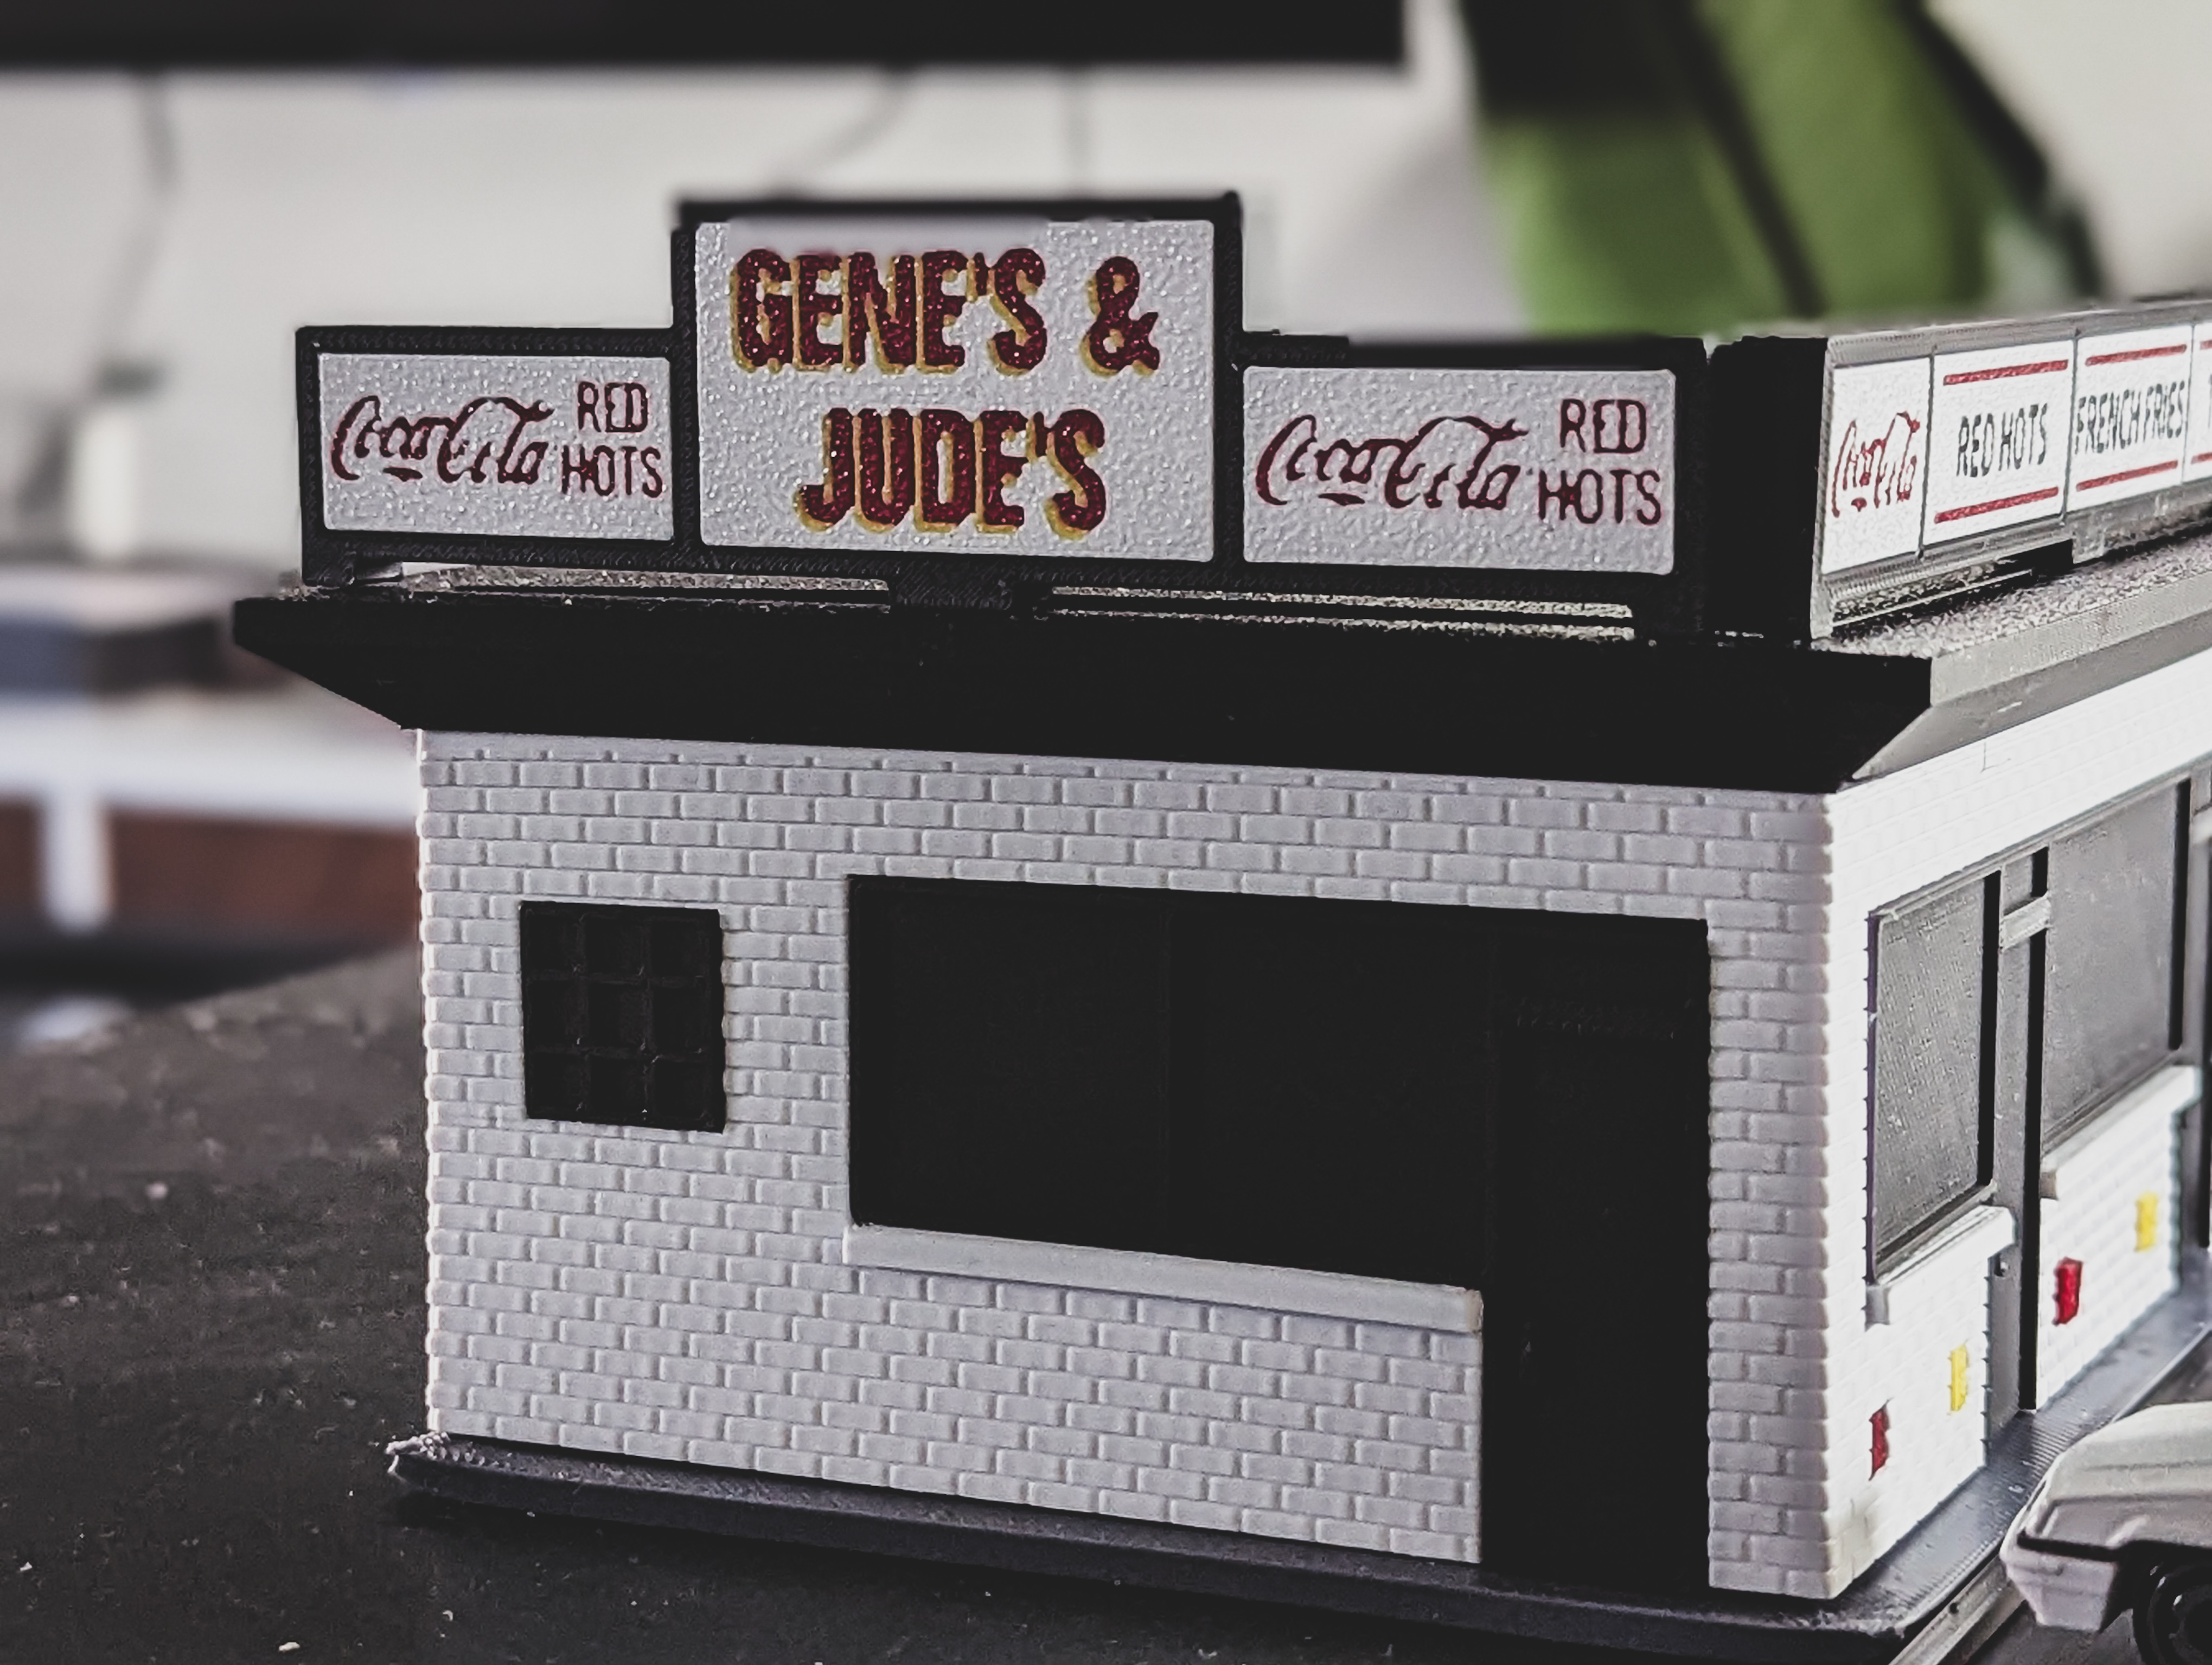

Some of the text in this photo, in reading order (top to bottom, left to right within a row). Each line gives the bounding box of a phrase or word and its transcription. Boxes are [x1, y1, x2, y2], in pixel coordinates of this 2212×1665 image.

[730, 247, 1160, 376] GENE'S &
[577, 381, 649, 433] RED
[1559, 399, 1647, 454] RED
[2075, 388, 2140, 454] FRENCH
[2143, 381, 2186, 443] FRIES
[561, 445, 666, 498] HOTS
[1956, 402, 2048, 478] RED HOTS
[793, 407, 1105, 540] JUDE'S
[1538, 468, 1661, 526] HOTS
